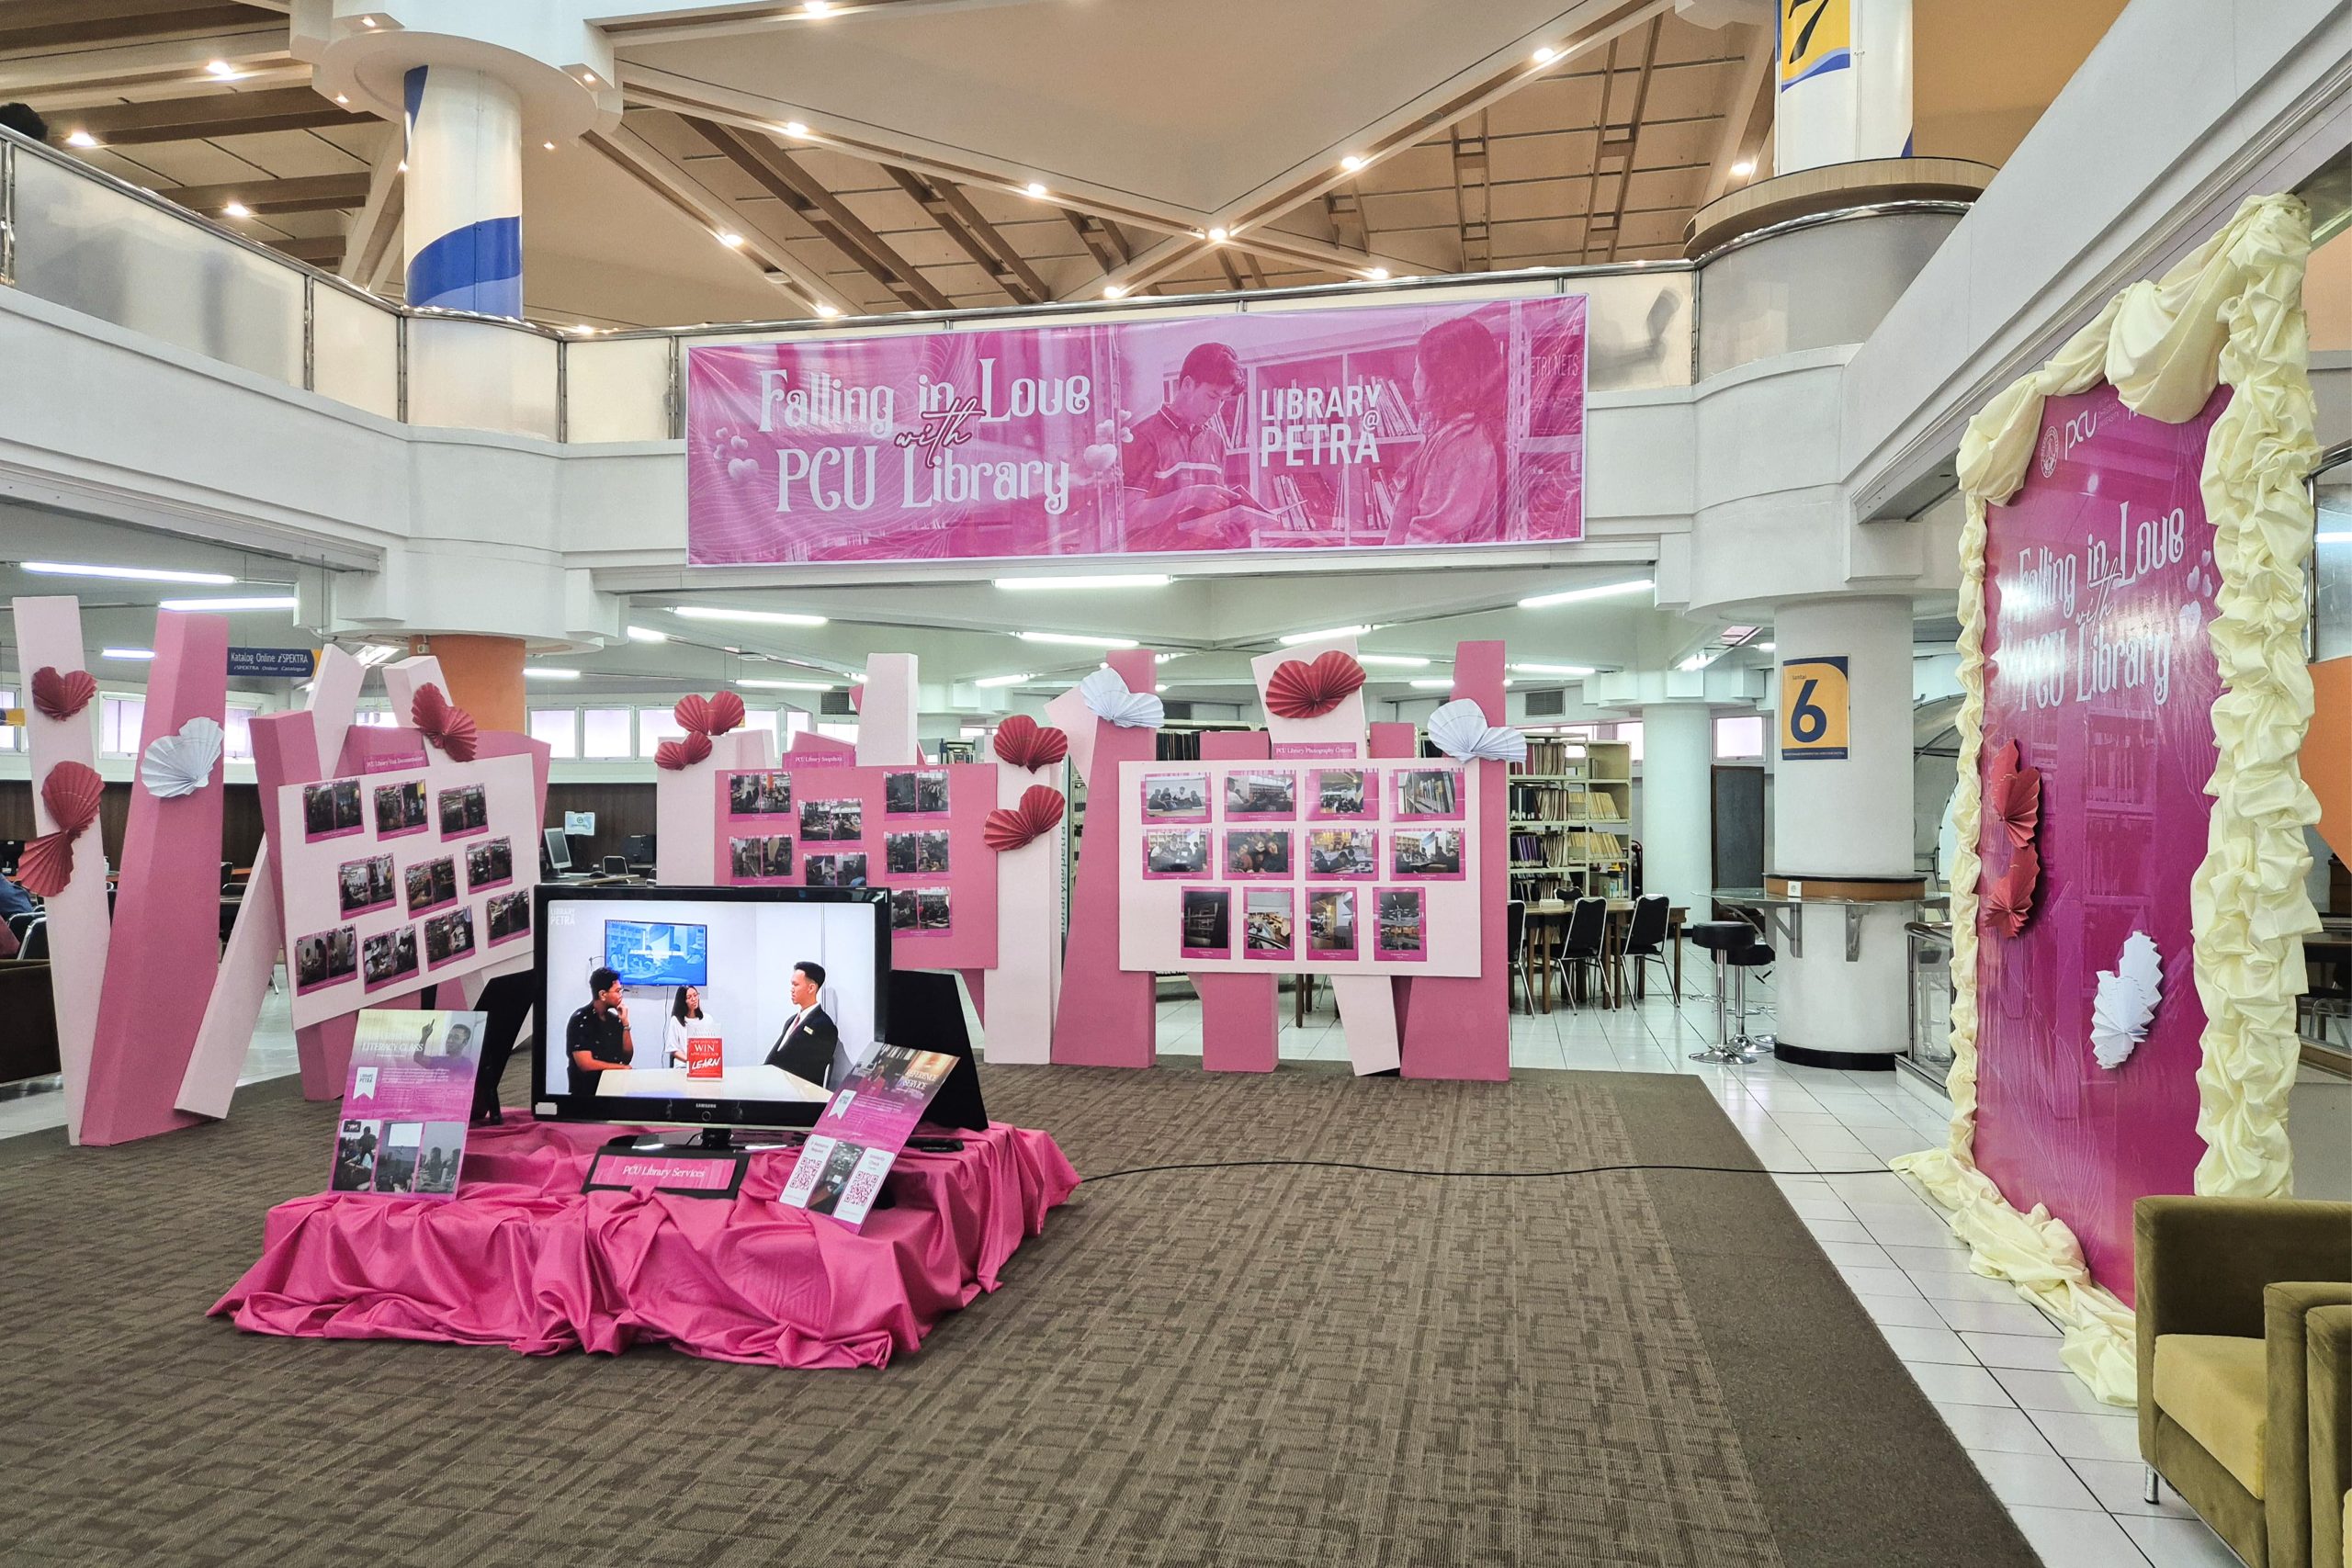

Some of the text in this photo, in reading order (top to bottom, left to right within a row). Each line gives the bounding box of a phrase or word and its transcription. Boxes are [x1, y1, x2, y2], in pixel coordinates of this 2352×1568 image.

[1788, 0, 1829, 64] 7
[758, 358, 1091, 437] Falling in Love
[1261, 383, 1381, 422] LIBRARY
[1363, 410, 1379, 432] @
[894, 397, 987, 468] with
[1261, 424, 1381, 468] PETRA
[775, 445, 1069, 515] PCU Library
[2018, 501, 2185, 619] Falling in Love
[2075, 557, 2122, 648] with
[231, 652, 254, 664] Katalog
[256, 653, 276, 662] Online
[2075, 623, 2172, 705] Library
[1791, 679, 1827, 743] 6
[692, 1057, 721, 1070] LEARN
[694, 1043, 715, 1052] WIN
[622, 1164, 706, 1179] PCU Library Services
